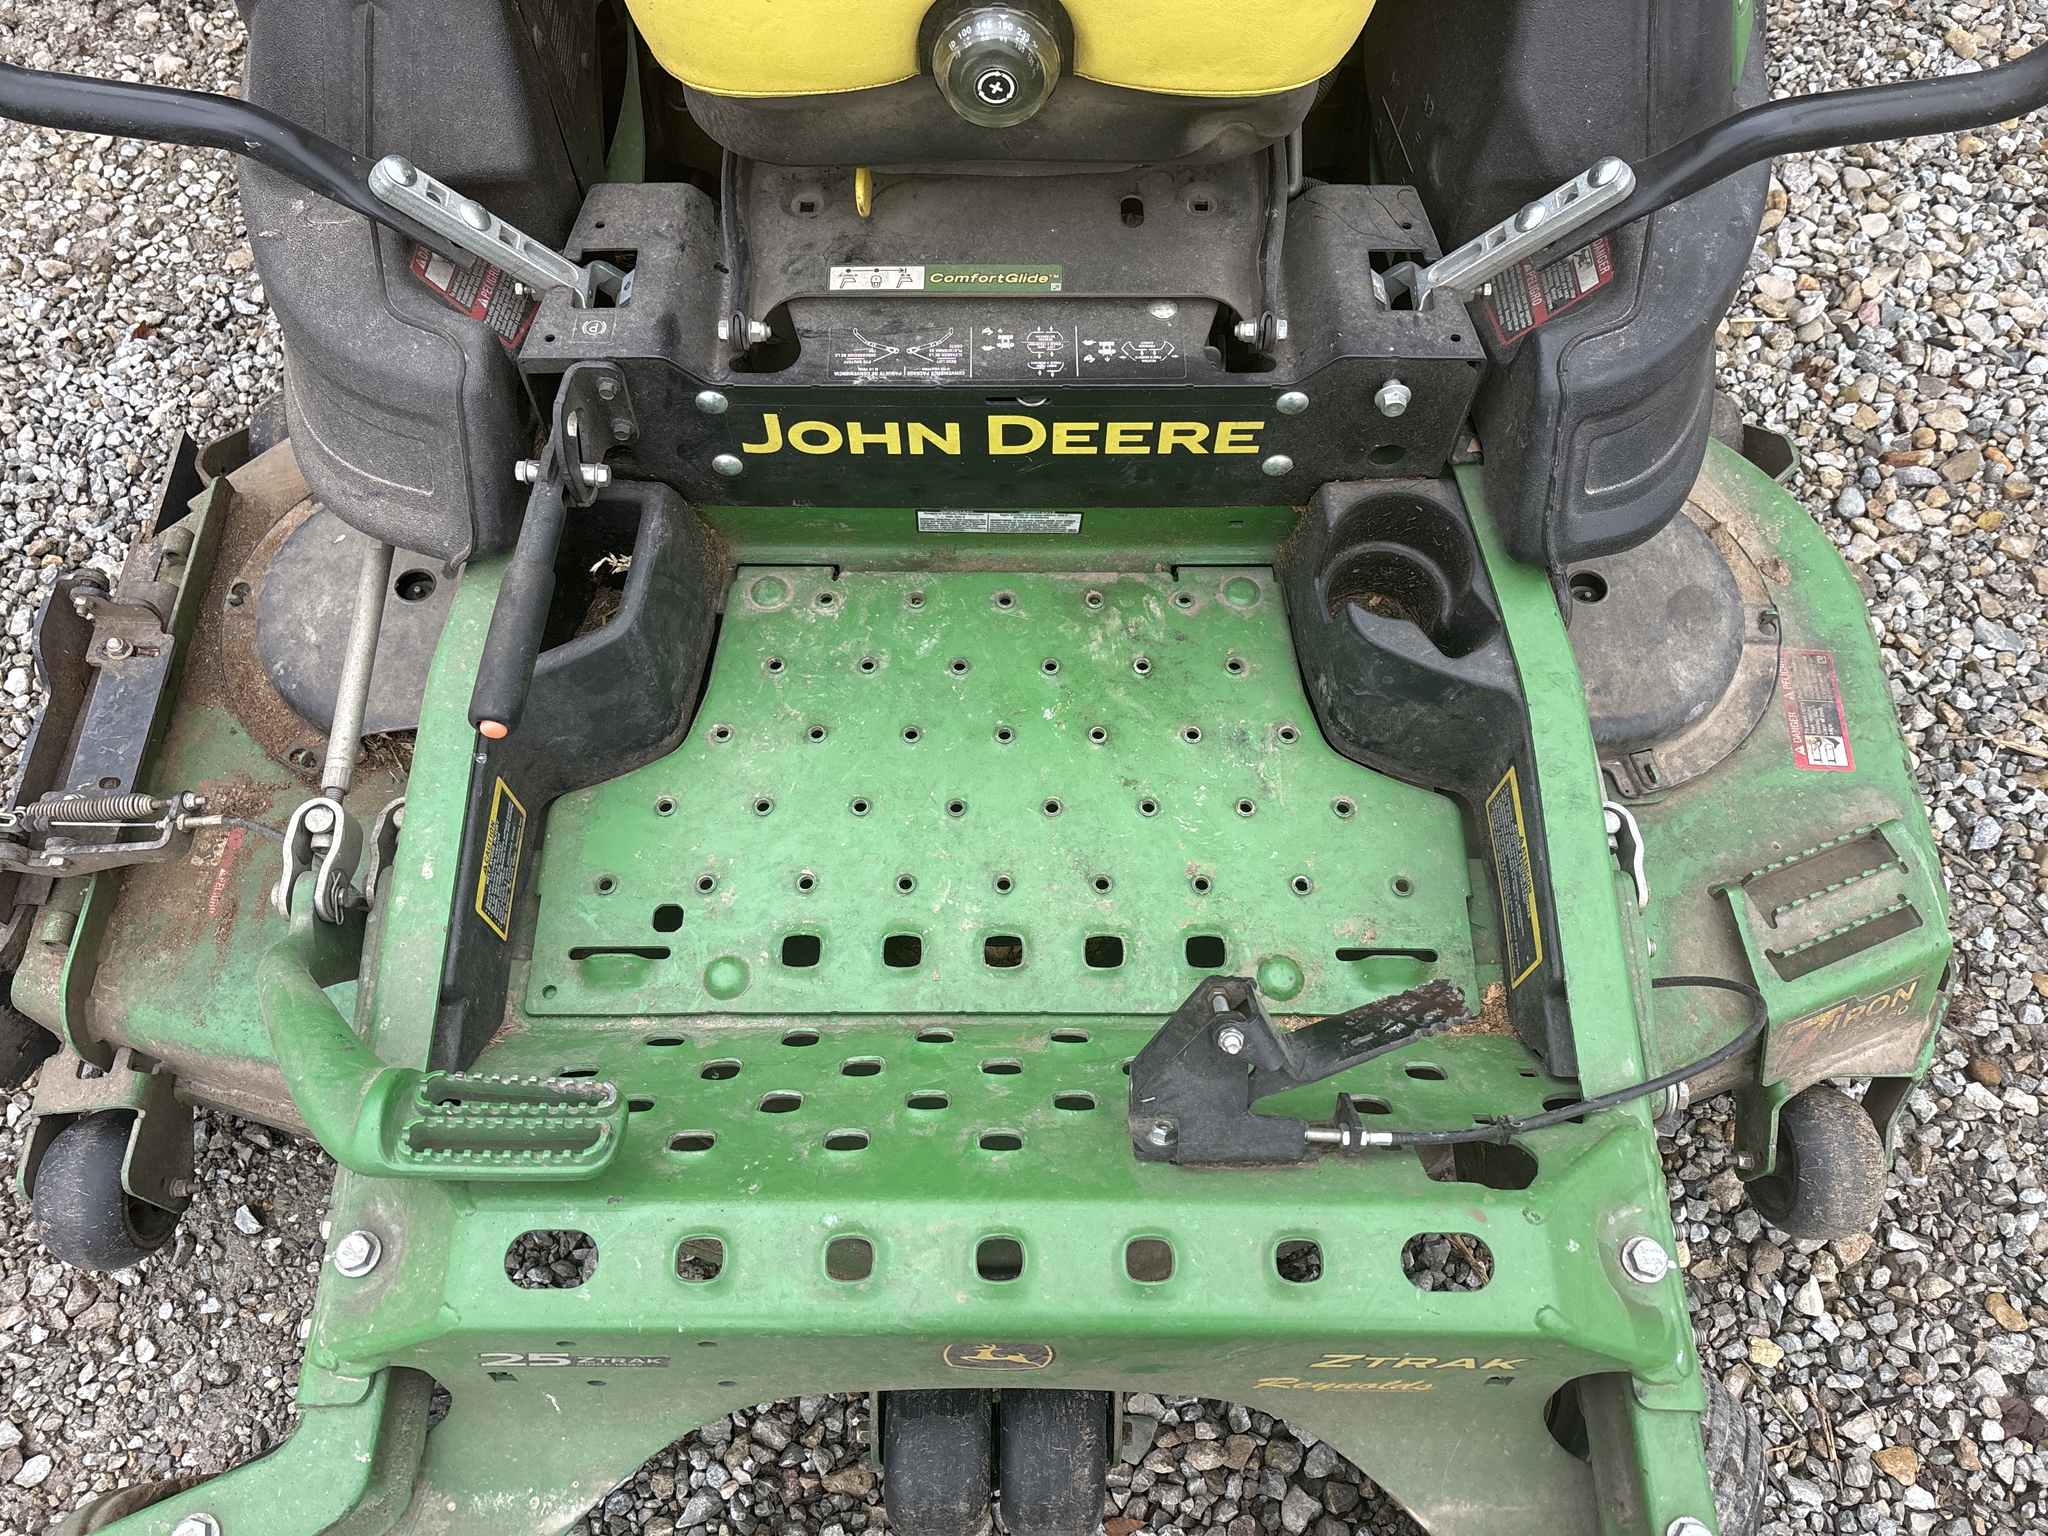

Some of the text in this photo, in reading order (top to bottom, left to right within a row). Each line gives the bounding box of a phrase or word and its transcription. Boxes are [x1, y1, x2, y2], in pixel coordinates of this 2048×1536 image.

[957, 26, 972, 40] 100
[976, 20, 993, 30] 145
[997, 21, 1013, 31] 190
[480, 265, 501, 301] PELIGRO
[1525, 269, 1543, 307] PELIGRO
[742, 413, 1265, 455] JOHN DEERE
[1788, 712, 1802, 743] DANGER
[484, 820, 495, 864] CAUTION
[1521, 843, 1533, 895] ATENCION
[480, 1352, 663, 1367] 25 ZTRAK
[1309, 1354, 1529, 1370] ZTRAK
